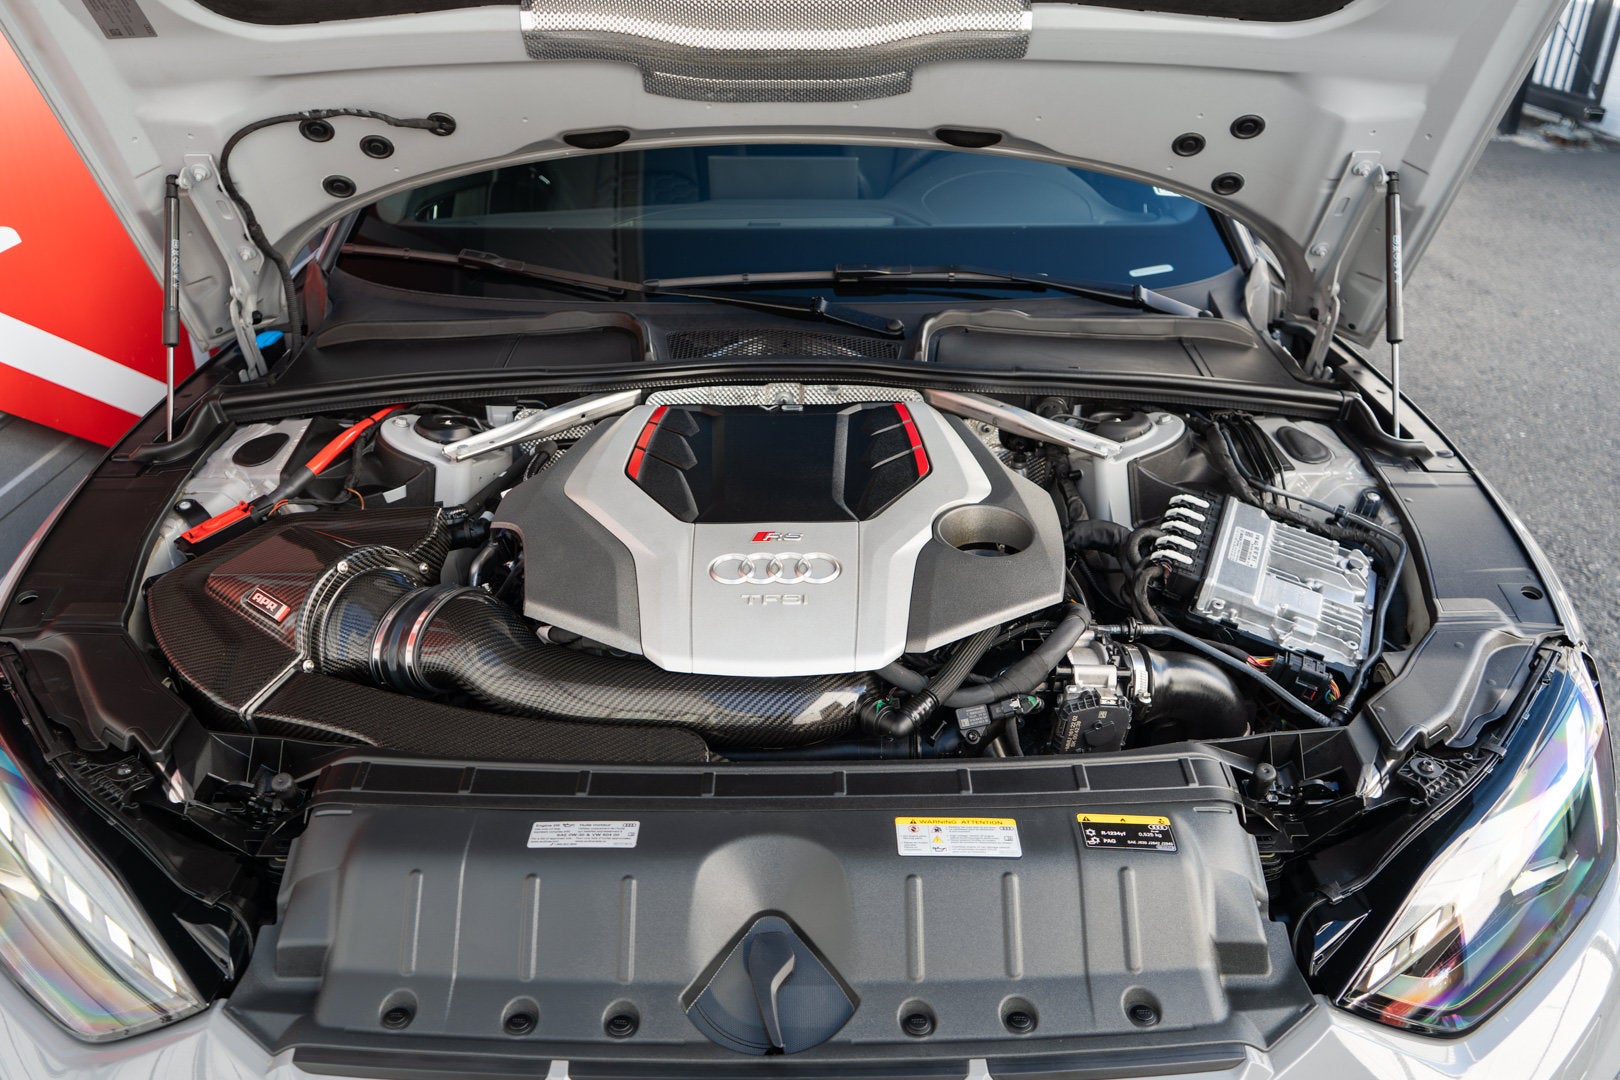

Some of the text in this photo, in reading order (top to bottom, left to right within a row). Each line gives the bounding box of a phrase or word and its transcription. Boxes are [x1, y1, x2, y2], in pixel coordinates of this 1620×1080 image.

[753, 531, 803, 541] RS
[252, 592, 278, 612] APR
[741, 594, 808, 605] TFSI
